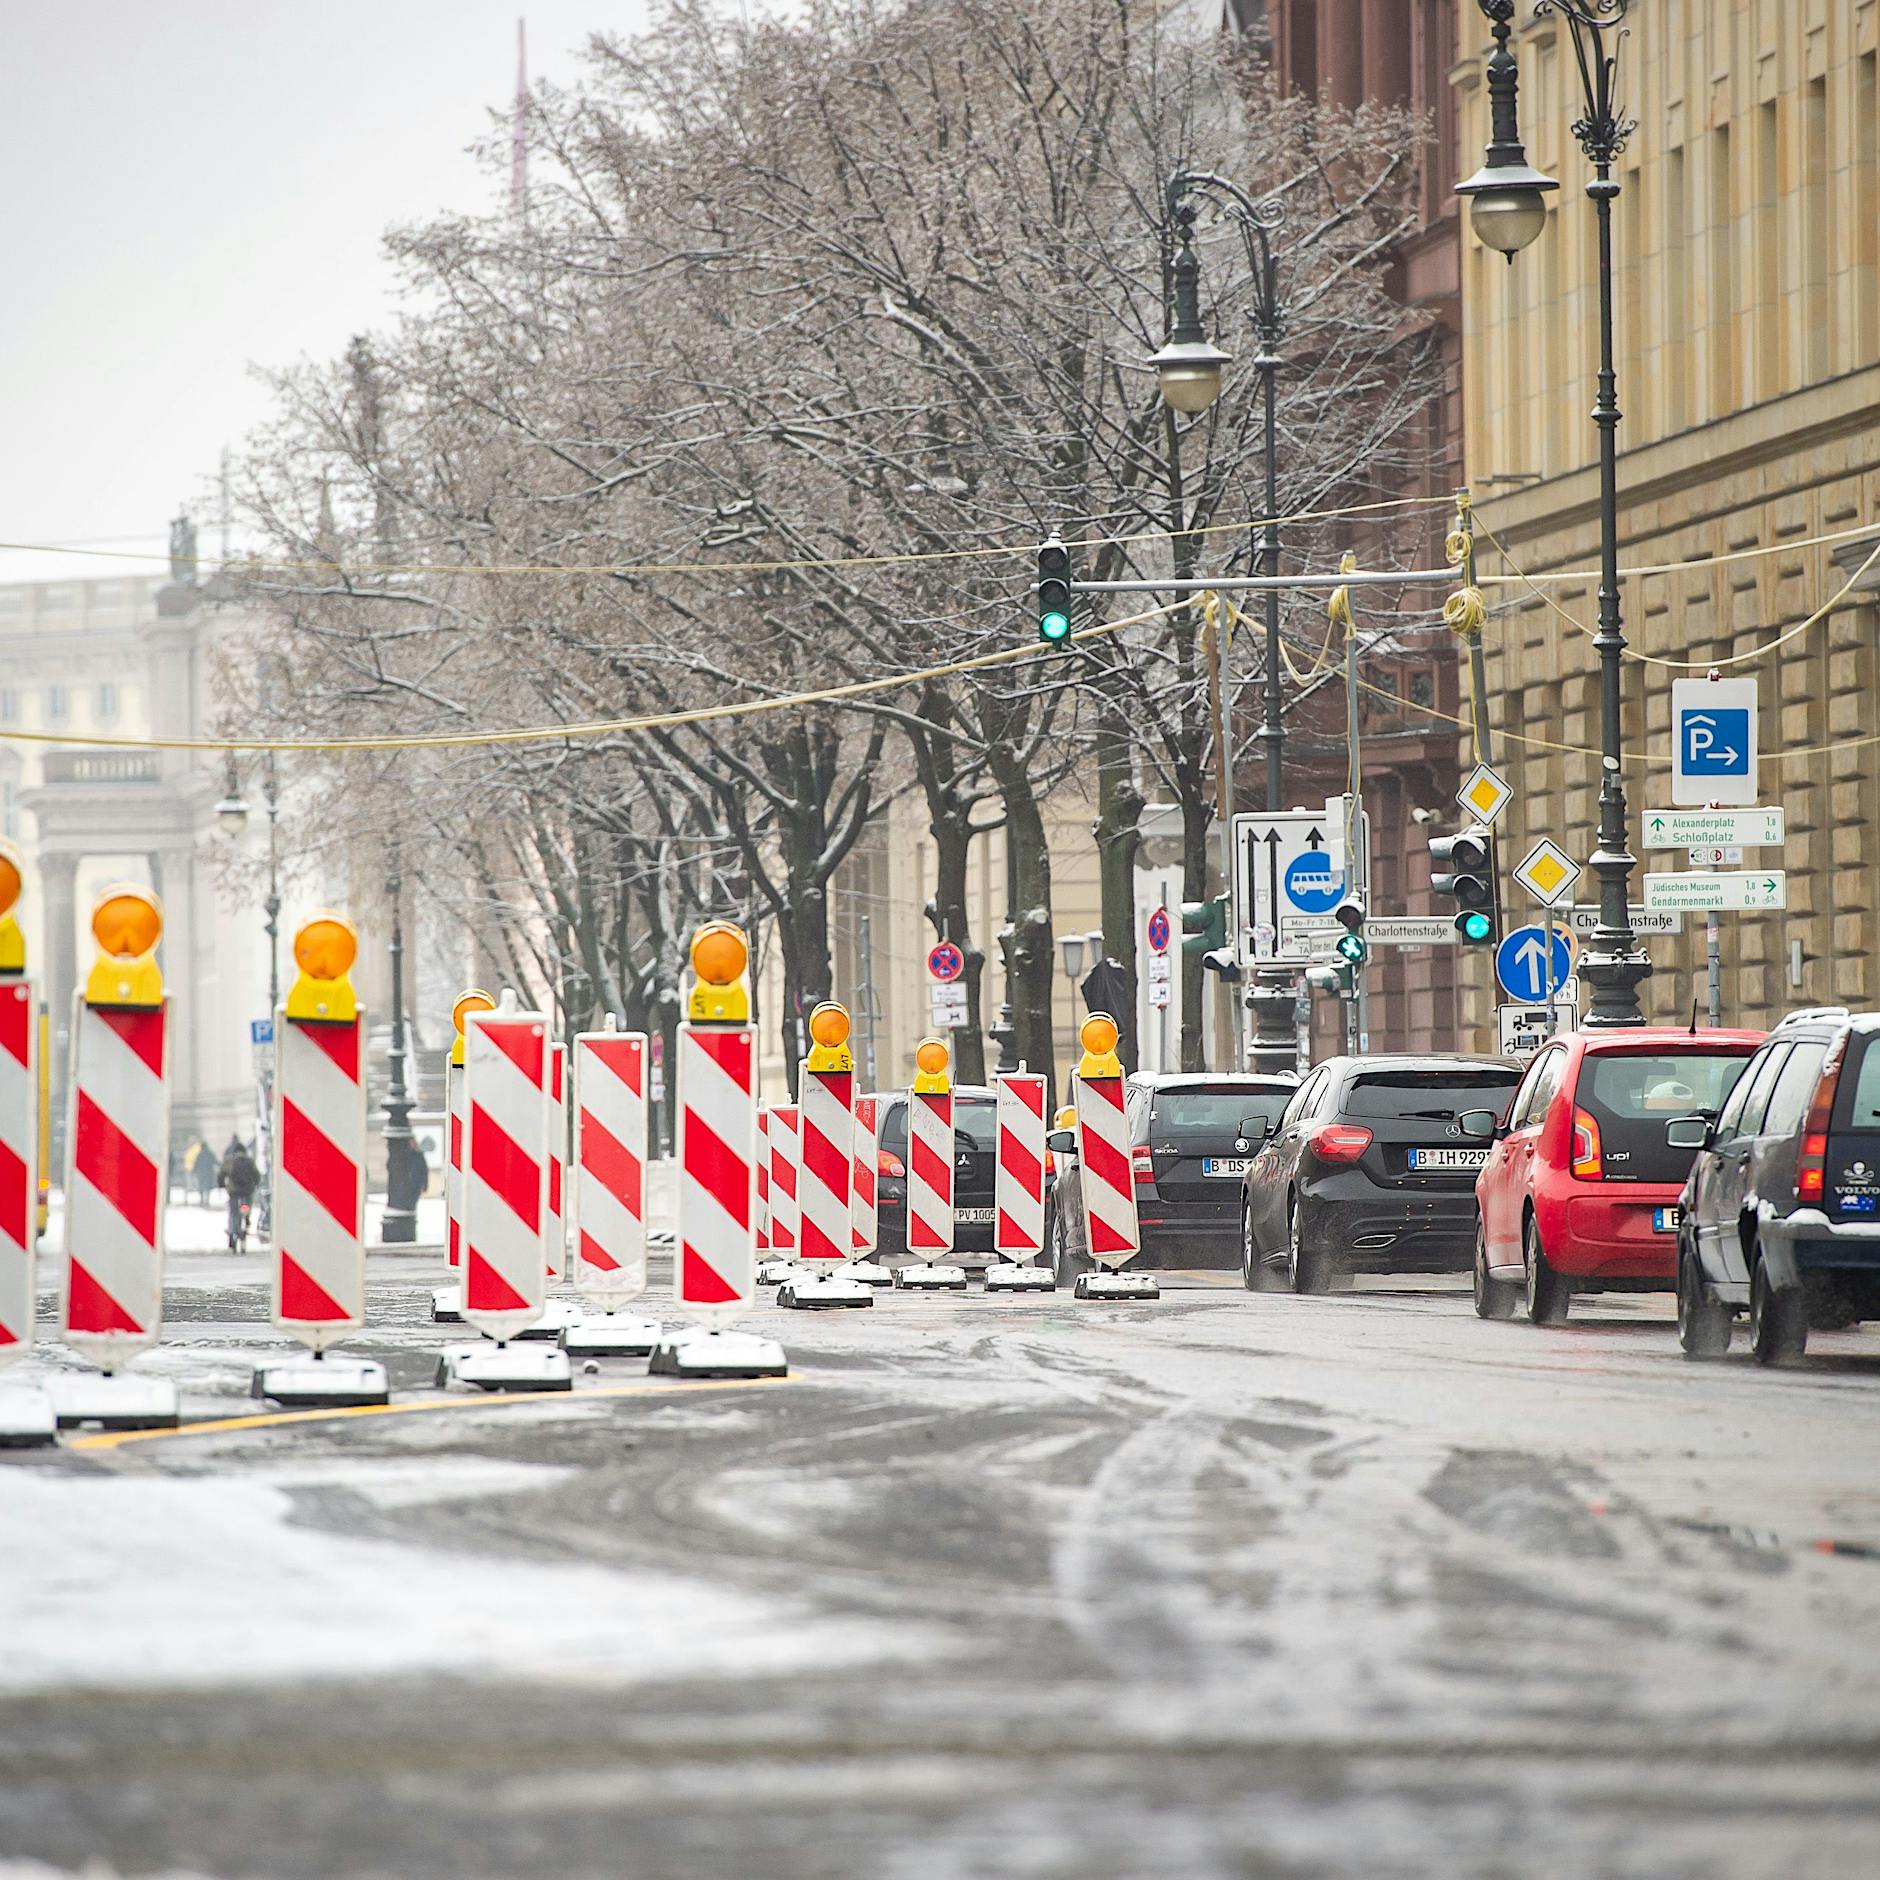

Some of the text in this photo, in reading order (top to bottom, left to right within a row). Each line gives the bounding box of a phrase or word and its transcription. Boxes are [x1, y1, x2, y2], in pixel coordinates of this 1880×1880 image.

[1690, 728, 1714, 761] P
[1672, 818, 1735, 829] Alexanderplatz
[1673, 831, 1734, 843] Schloßplatz
[1652, 882, 1688, 892] Jüdisches
[1690, 882, 1721, 891] Museum
[1651, 896, 1723, 906] Gendarmenmarkt
[1577, 914, 1673, 930] Chanstraße
[1368, 924, 1448, 939] Charlottenstraße
[1418, 1151, 1490, 1165] B IH 929
[1606, 1151, 1630, 1161] up!
[1211, 1160, 1220, 1172] B
[1228, 1160, 1245, 1172] DS
[1834, 1186, 1880, 1195] VOLVO
[958, 1209, 971, 1220] PV
